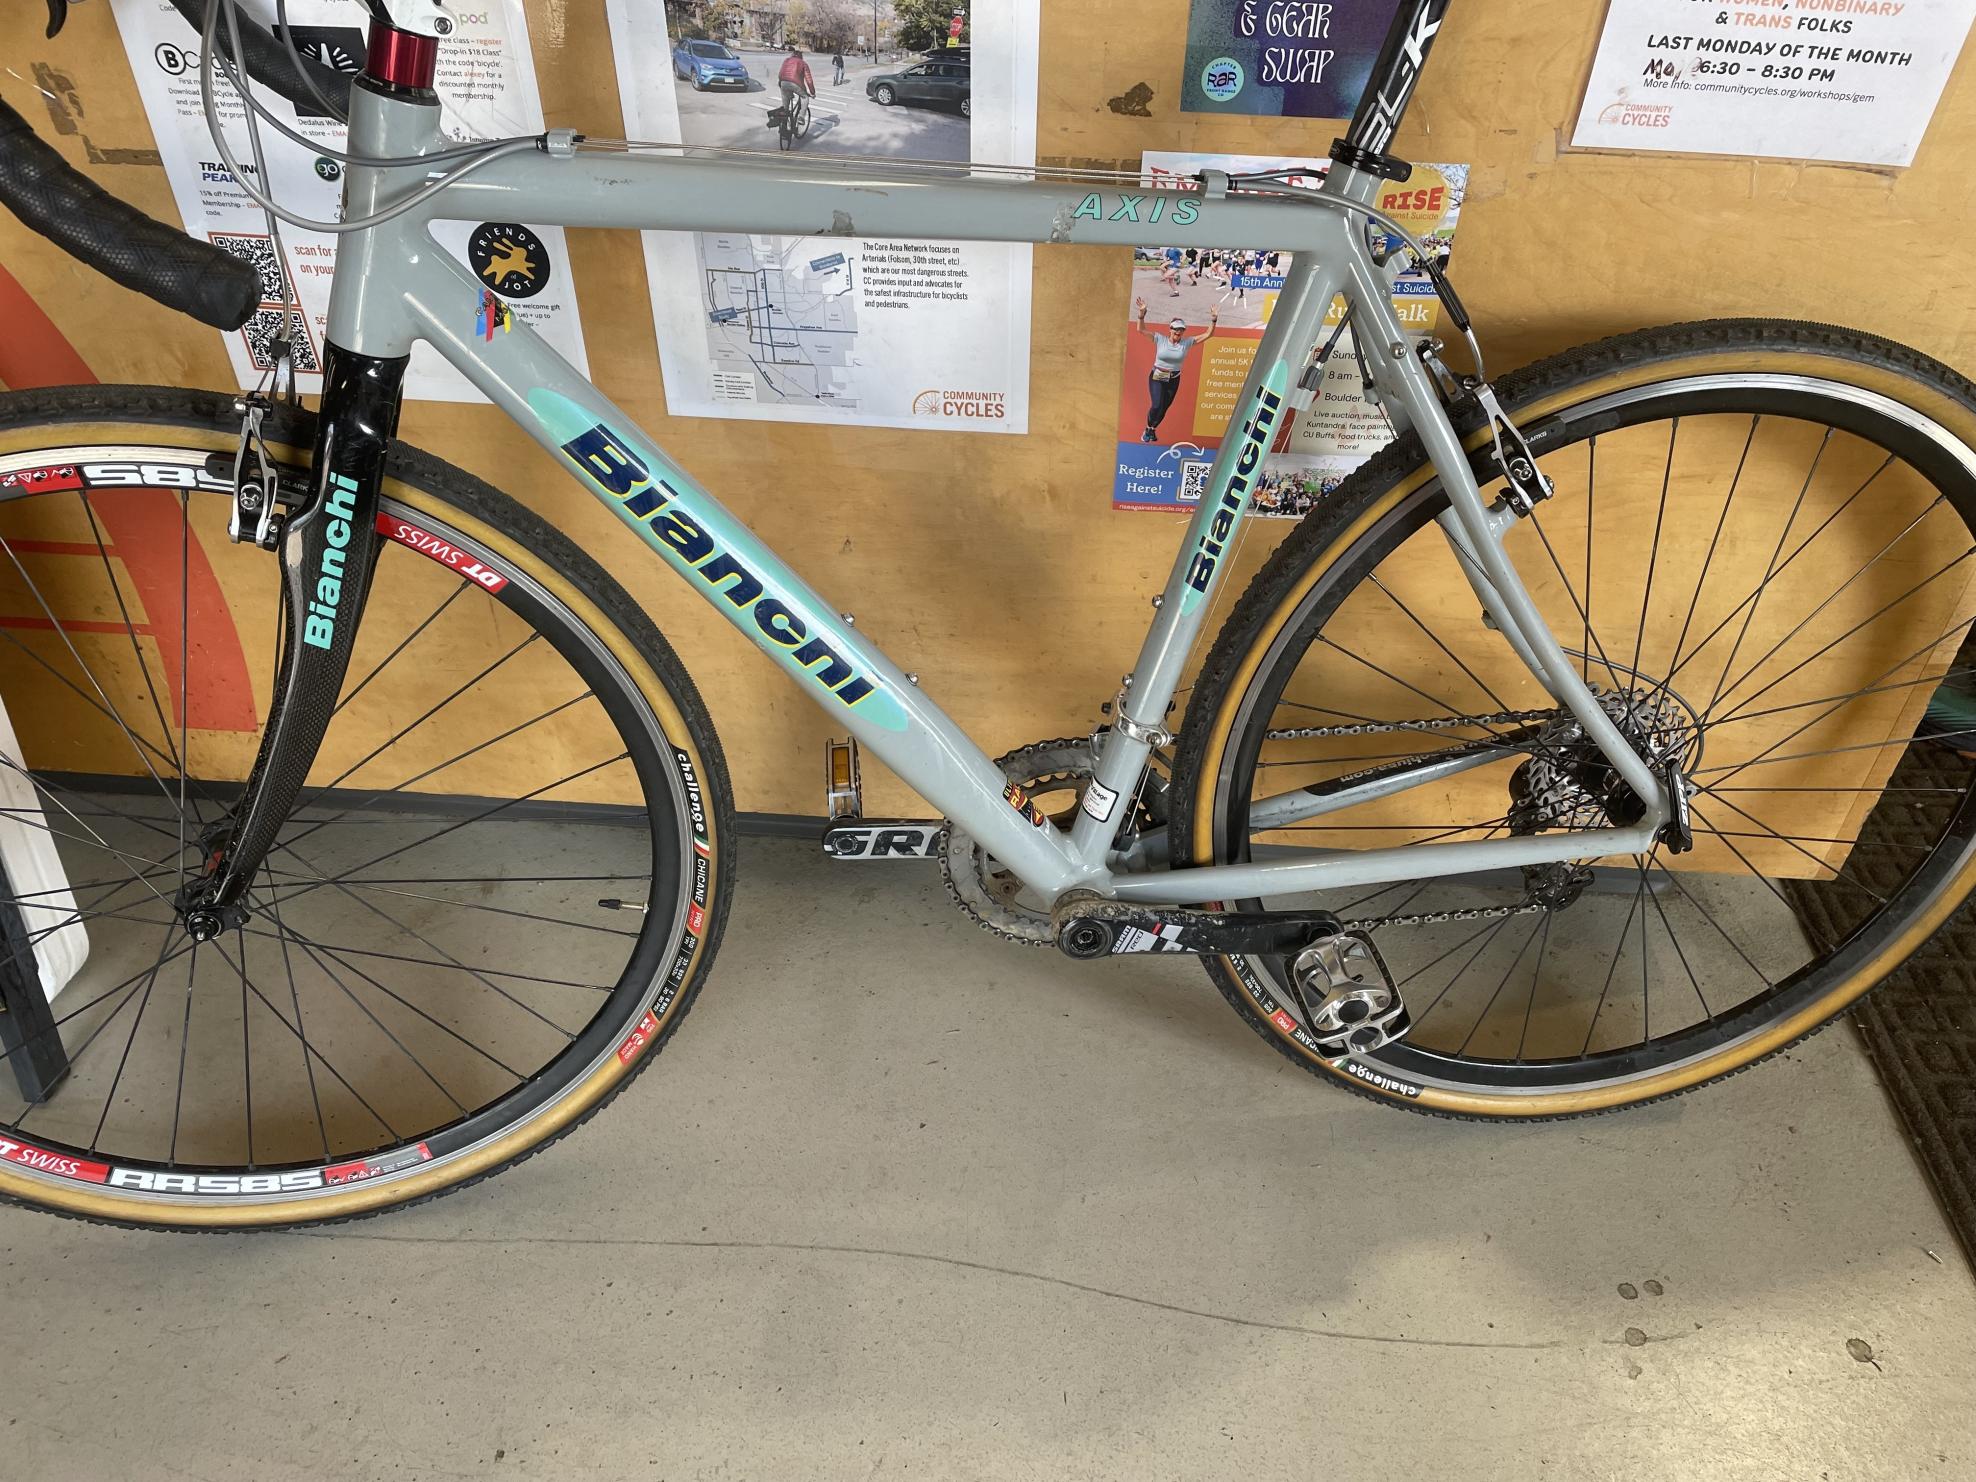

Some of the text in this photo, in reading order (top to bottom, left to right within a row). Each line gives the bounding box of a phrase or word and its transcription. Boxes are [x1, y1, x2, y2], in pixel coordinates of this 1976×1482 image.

[1796, 0, 1904, 16] NONBINARY
[1715, 11, 1853, 33] & TRANS FOLKS
[1647, 34, 1912, 66] LAST MONDAY OF THE MONTH
[437, 69, 463, 77] Contact
[1700, 60, 1835, 82] 6:30 8:30 PM
[477, 83, 504, 91] monthly
[1643, 78, 1875, 103] More Info: communitycycles.org/workshops/gem
[452, 92, 496, 100] membership.
[189, 100, 201, 109] join
[1625, 104, 1674, 114] COMMUNITY
[298, 118, 324, 127] Dedalus
[1621, 114, 1670, 128] CYCLES
[1382, 186, 1444, 210] RISE
[202, 200, 241, 209] Membership
[1073, 193, 1201, 225] AXIS
[477, 227, 536, 256] FRIENDS
[294, 245, 332, 257] scan for
[863, 243, 874, 251] The
[875, 243, 888, 251] Core
[889, 243, 902, 251] Area
[904, 244, 928, 252] Network
[929, 245, 950, 253] focuses
[888, 256, 911, 264] (Folsom,
[913, 256, 926, 264] 30th
[928, 257, 946, 265] street,
[300, 264, 313, 273] on
[863, 266, 879, 274] which
[917, 268, 946, 277] dangerous
[947, 269, 968, 277] streets.
[504, 280, 531, 291] JOT
[873, 278, 896, 286] provides
[898, 279, 911, 287] input
[925, 280, 953, 288] advocates
[1240, 276, 1260, 287] 15th
[893, 289, 931, 298] infrastructure
[942, 291, 968, 300] bicyclists
[551, 303, 561, 311] gift
[876, 301, 909, 309] pedestrians.
[1328, 371, 1335, 379] 8
[943, 391, 1004, 402] COMMUNITY
[1324, 393, 1362, 402] Boulder
[943, 401, 1004, 418] CYCLES
[1331, 412, 1361, 420] auction,
[1338, 432, 1356, 440] food
[1357, 432, 1381, 440] trucks,
[1119, 464, 1174, 478] Register
[1126, 482, 1162, 494] Here!
[1185, 385, 1283, 594] Bianchi
[304, 472, 359, 649] Bianchi
[394, 525, 502, 587] DT SWISS
[560, 423, 884, 707] Bianchi
[677, 753, 704, 832] challenge
[694, 858, 706, 903] CHICANE
[693, 912, 703, 928] PRO
[1277, 1017, 1290, 1029] PRO
[1348, 1064, 1416, 1095] challenge
[16, 1149, 81, 1176] SWISS
[110, 1168, 323, 1192] RR585
